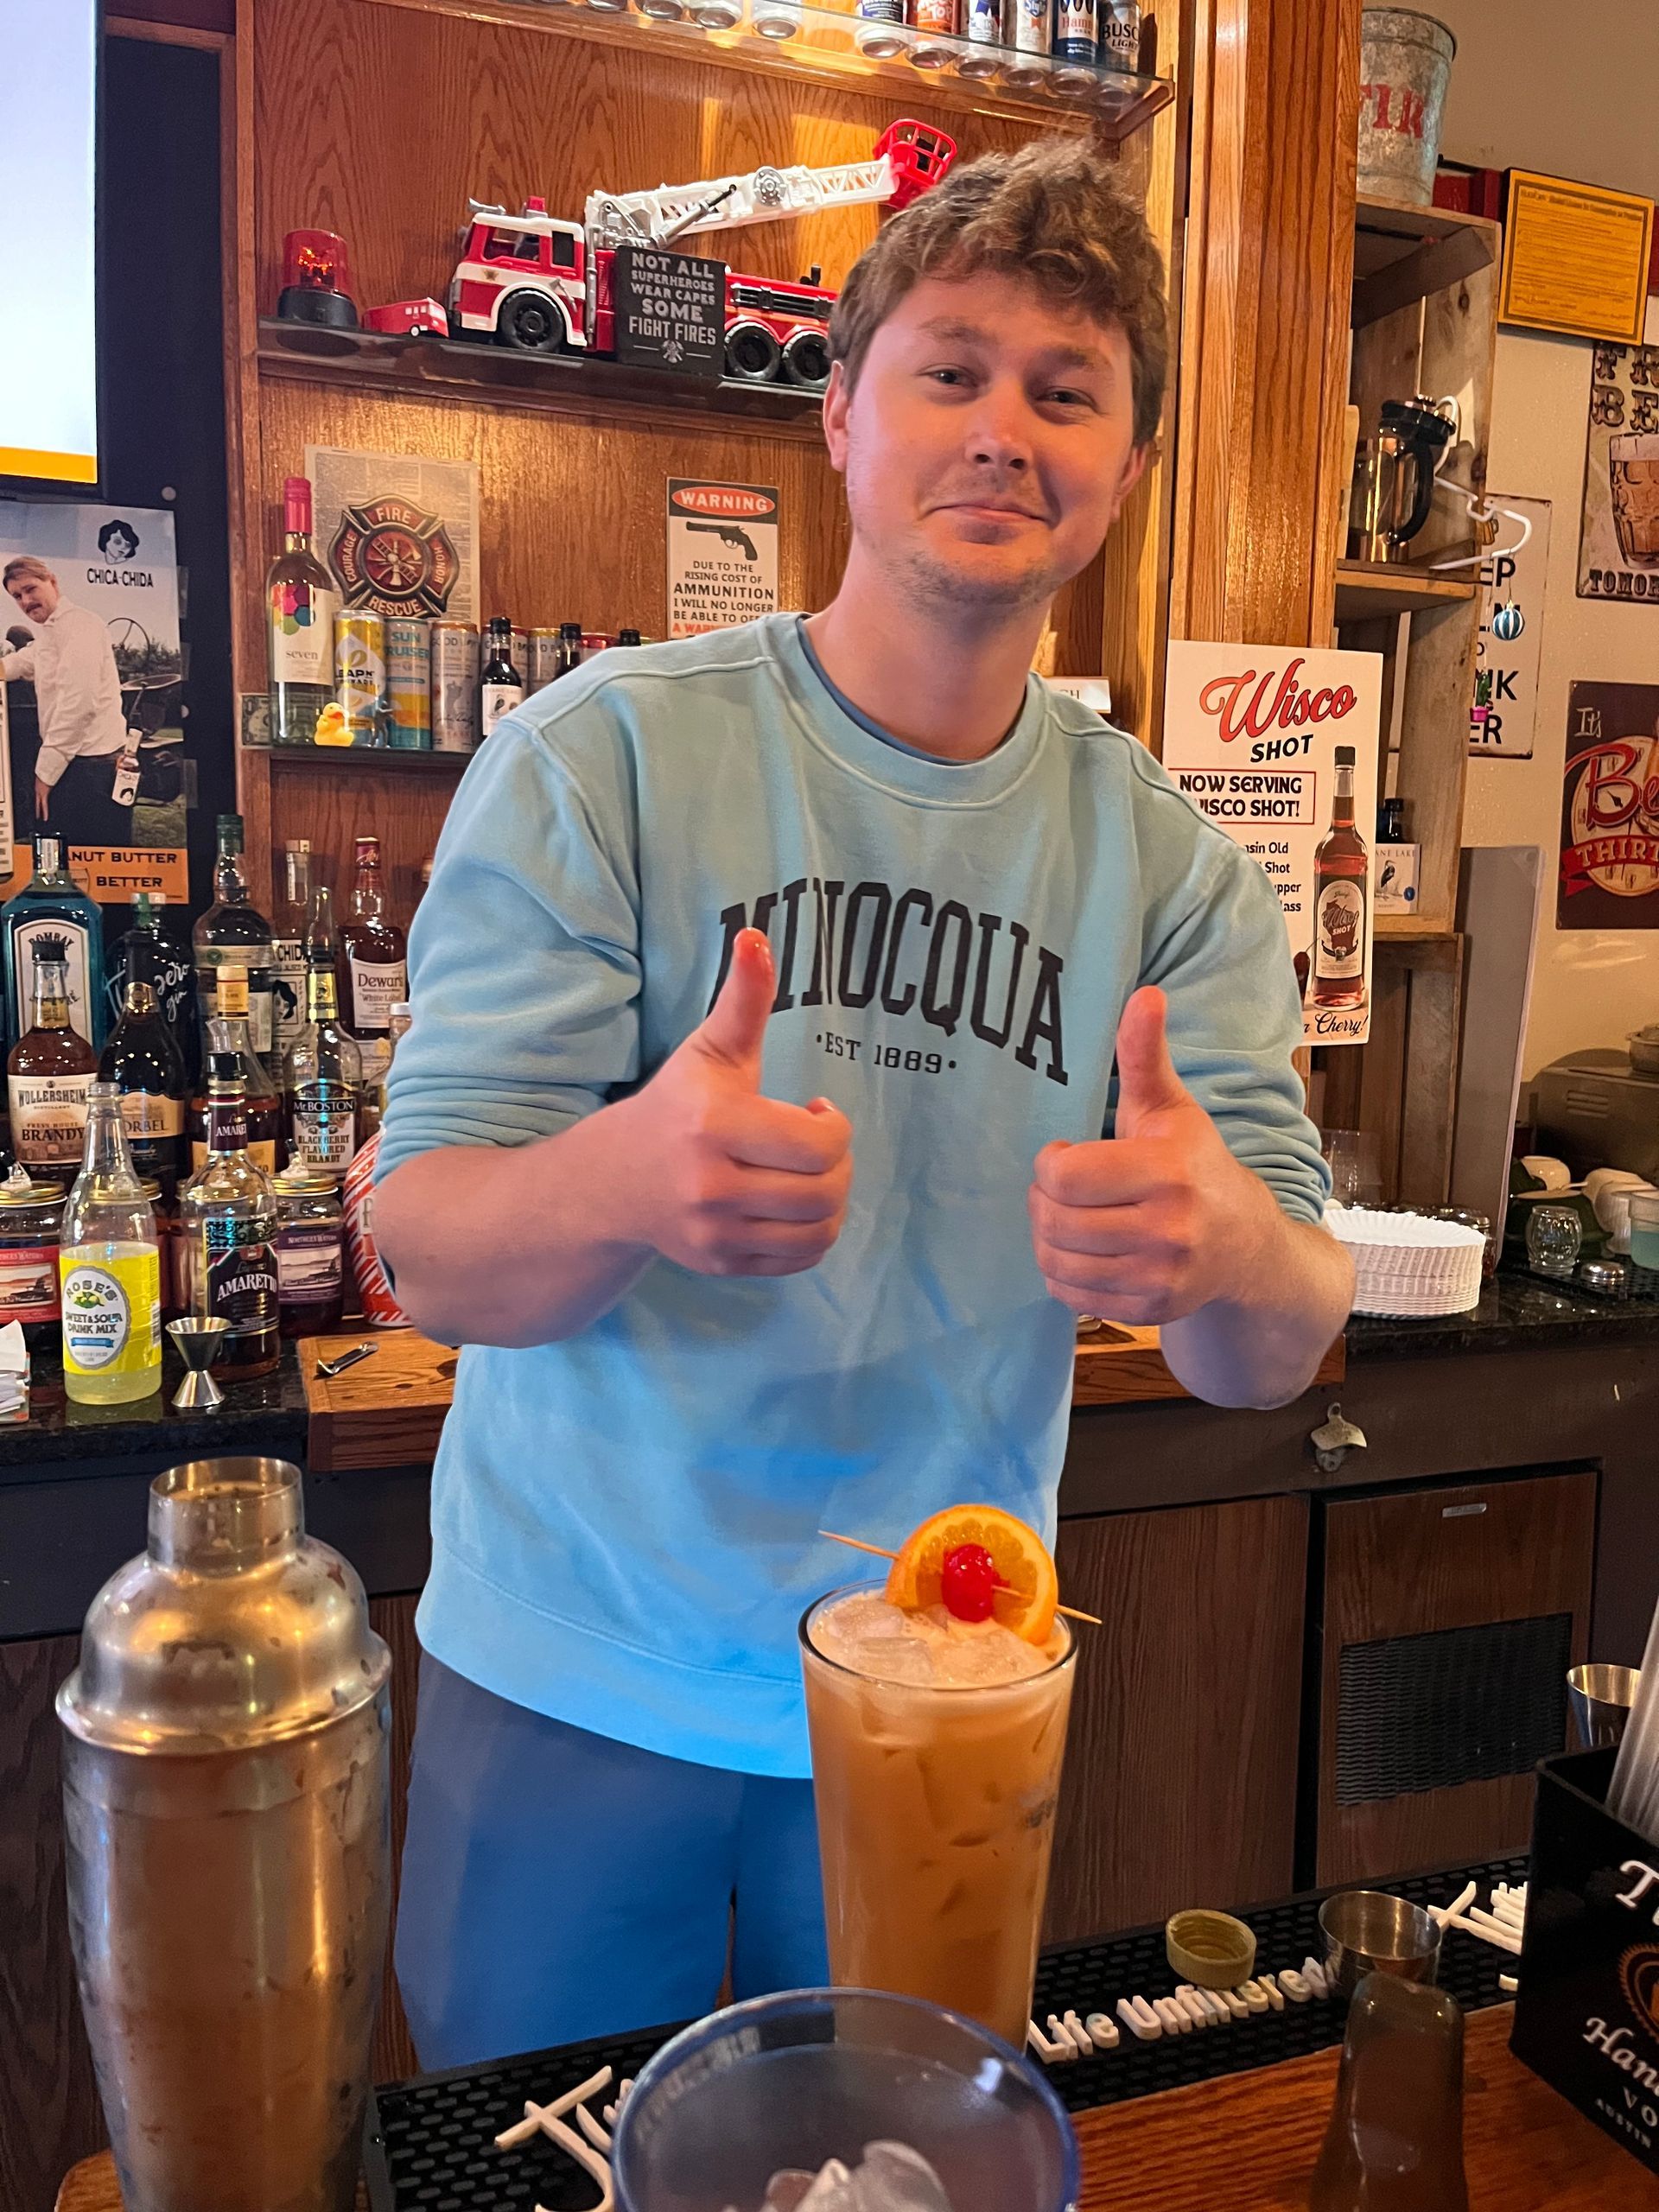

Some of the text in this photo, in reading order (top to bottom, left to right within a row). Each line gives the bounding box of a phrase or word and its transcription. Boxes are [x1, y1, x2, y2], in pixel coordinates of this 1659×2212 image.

[632, 252, 714, 279] NOT ALL
[631, 270, 715, 292] SUPERHEROES
[631, 283, 715, 306] WEAR CAPES
[642, 298, 703, 323] SOME
[629, 315, 716, 346] FIGHT FIRES
[681, 491, 767, 512] WARNING
[376, 507, 411, 524] FIRE
[342, 533, 357, 583] COURAGE
[434, 546, 446, 585] HONOR
[693, 561, 753, 573] DUE TO THE
[86, 568, 155, 588] CHICA-CHIDA
[684, 571, 719, 582] RISING
[721, 574, 747, 583] COST
[674, 582, 774, 600] AMMUNITION
[369, 595, 423, 616] RESCUE
[674, 598, 773, 613] I WILL NO LONGER
[674, 611, 687, 620] BE
[691, 613, 718, 622] ABLE
[722, 614, 735, 623] TO
[672, 623, 683, 632] A
[391, 632, 421, 643] SUN
[285, 650, 319, 660] seven
[1199, 658, 1357, 743] Wisco
[1250, 734, 1314, 763] SHOT
[1179, 774, 1302, 794] NOW SERVING
[1250, 799, 1300, 817] SHOT!
[1268, 842, 1289, 855] Old
[111, 852, 177, 864] BUTTER
[1265, 861, 1291, 874] Shot
[96, 876, 162, 888] BETTER
[29, 932, 74, 947] BOMBAY
[1332, 925, 1351, 936] SHOT
[706, 877, 1068, 1086] MINOCQUA
[1314, 1012, 1370, 1036] Cherry!
[824, 1032, 943, 1074] EST 1889
[18, 1087, 86, 1108] WOLLERSHEIM
[308, 1101, 353, 1111] BOSTON
[22, 1128, 86, 1141] BRANDY
[307, 1154, 341, 1164] BRANDY
[67, 1280, 118, 1301] ROSE'S
[68, 1324, 118, 1334] DRINK MIX
